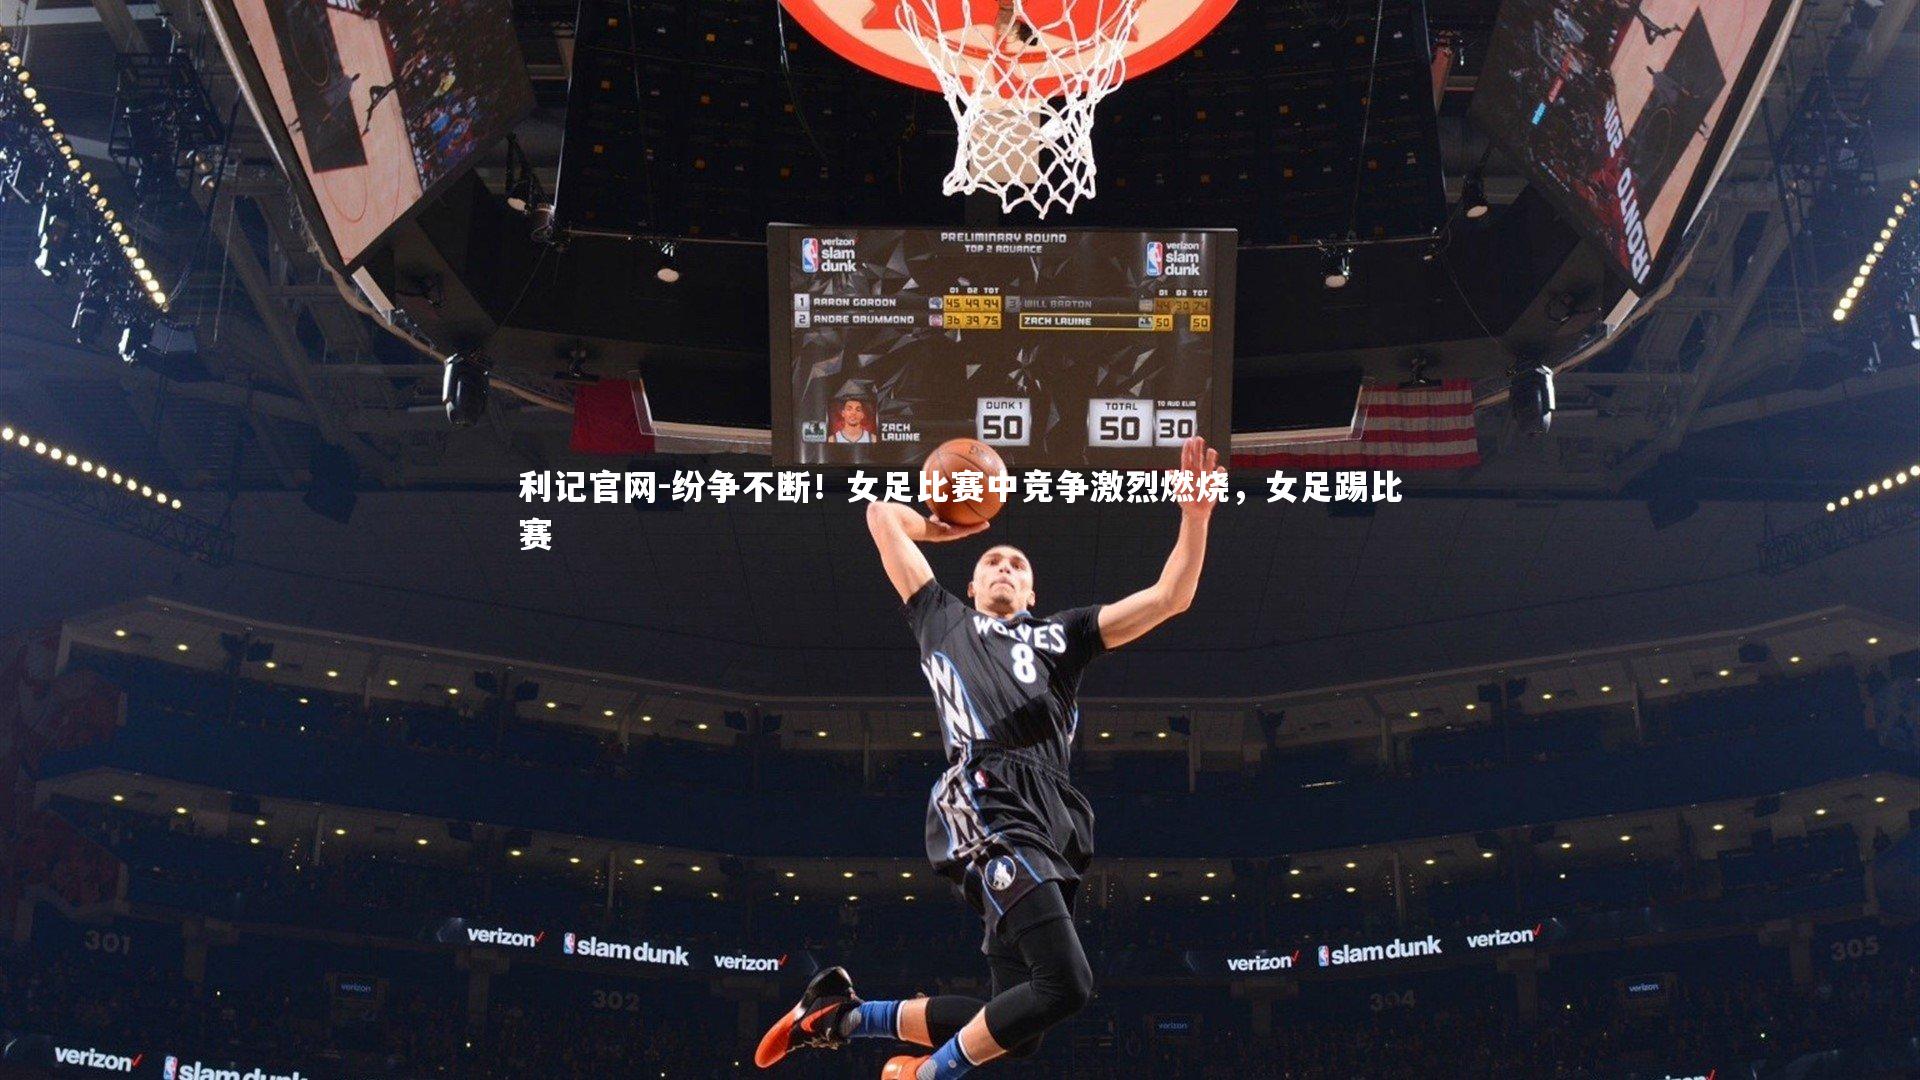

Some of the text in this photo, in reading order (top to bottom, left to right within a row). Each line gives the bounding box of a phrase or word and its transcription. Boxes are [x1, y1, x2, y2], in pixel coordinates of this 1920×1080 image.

[821, 237, 855, 246] verizon
[940, 232, 1067, 243] PRELIMINARY ROUND
[821, 246, 855, 259] slam
[965, 244, 983, 253] TOP
[986, 245, 993, 253] 2
[1166, 242, 1199, 250] verizon
[1165, 250, 1199, 263] slam
[821, 259, 857, 272] dunk
[1164, 263, 1200, 276] dunk
[813, 298, 850, 307] AARON
[853, 298, 897, 307] GORDON
[946, 299, 960, 308] 45
[965, 299, 980, 308] 49
[983, 299, 999, 308] 94
[1024, 299, 1048, 308] WILL
[1050, 300, 1092, 309] BARTON
[799, 315, 806, 324] 2
[813, 315, 850, 323] ANDRE
[852, 315, 915, 324] DRUMMOND
[965, 316, 980, 325] 39
[983, 316, 999, 325] 75
[1024, 316, 1052, 325] ZACH
[1156, 318, 1170, 327] 50
[1193, 318, 1208, 327] 50
[986, 401, 1015, 409] DUNK
[1105, 402, 1138, 410] TOTAL
[881, 423, 911, 432] ZACH
[983, 415, 1023, 440] 50
[1100, 416, 1140, 441] 50
[1160, 419, 1193, 438] 30
[1010, 643, 1037, 684] 8
[84, 930, 130, 954] 301
[467, 927, 535, 948] verizon
[1467, 928, 1534, 948] verizon
[576, 936, 690, 967] slam dunk
[1330, 934, 1443, 966] slam dunk
[1830, 936, 1879, 962] 305
[713, 954, 779, 972] verizon
[1227, 956, 1293, 972] verizon
[55, 1046, 132, 1072] verizon
